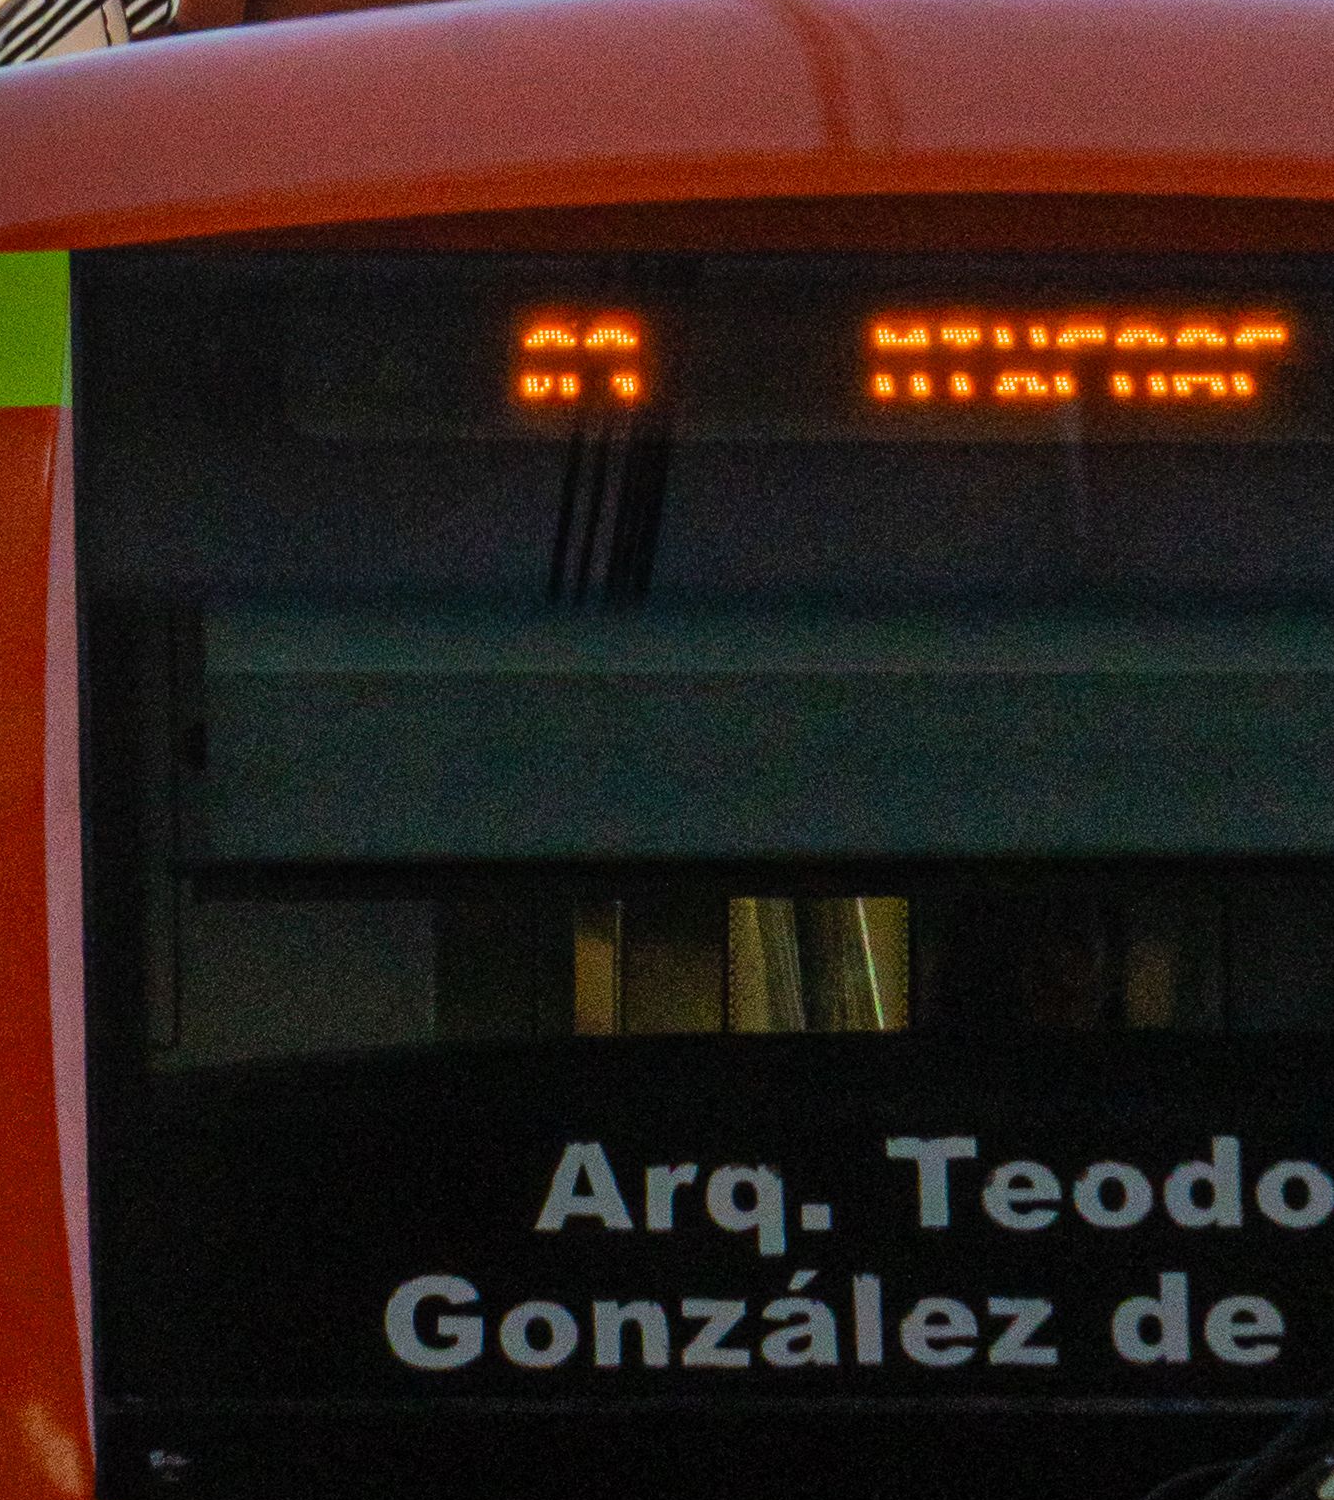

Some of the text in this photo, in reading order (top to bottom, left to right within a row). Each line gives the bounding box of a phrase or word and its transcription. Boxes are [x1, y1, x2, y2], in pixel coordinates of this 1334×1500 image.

[535, 1141, 832, 1257] Arq.
[383, 1272, 1059, 1371] González
[1111, 1274, 1286, 1366] de
